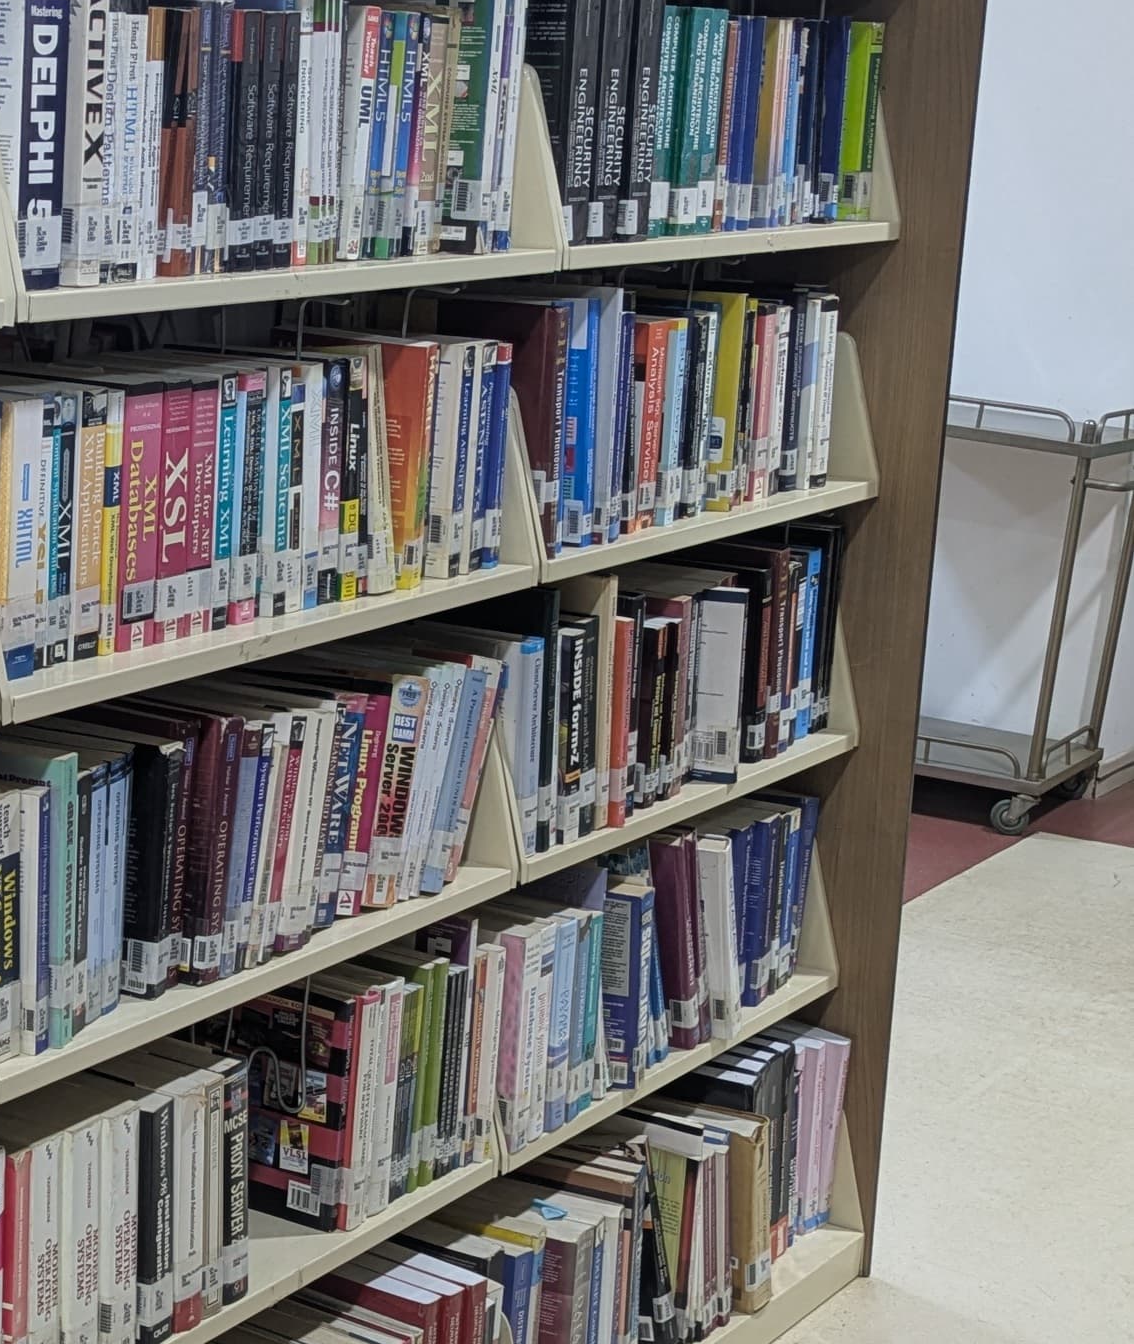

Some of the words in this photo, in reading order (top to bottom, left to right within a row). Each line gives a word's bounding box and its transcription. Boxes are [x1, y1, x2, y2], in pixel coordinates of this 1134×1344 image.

[31, 5, 63, 19] Mastering
[28, 24, 58, 185] DELPHI
[358, 85, 372, 129] UML
[375, 49, 391, 123] HTML5
[422, 71, 443, 161] XML
[574, 69, 588, 187] ENGINEERING
[582, 107, 594, 188] SECURITY
[27, 198, 52, 219] 5
[648, 347, 659, 413] Analysis
[219, 416, 234, 503] Learning
[279, 408, 292, 458] XML
[329, 407, 339, 466] INSIDE
[348, 424, 360, 471] Linux
[125, 440, 143, 582] Databases
[143, 474, 158, 542] XML
[162, 448, 189, 563] XSL
[278, 463, 289, 548] Schema
[324, 469, 339, 511] C#
[16, 508, 33, 568] XHTML
[219, 508, 230, 554] XML
[572, 638, 584, 701] INSIDE
[393, 727, 414, 742] DAMN
[394, 715, 417, 726] BEST
[3, 803, 12, 840] teach
[2, 869, 14, 971] Windows
[224, 1111, 248, 1135] MCSE
[230, 1131, 244, 1176] PROXY
[231, 1180, 244, 1239] SERVER
[76, 1239, 85, 1300] SYSTEMS
[85, 1223, 93, 1307] OPERATING
